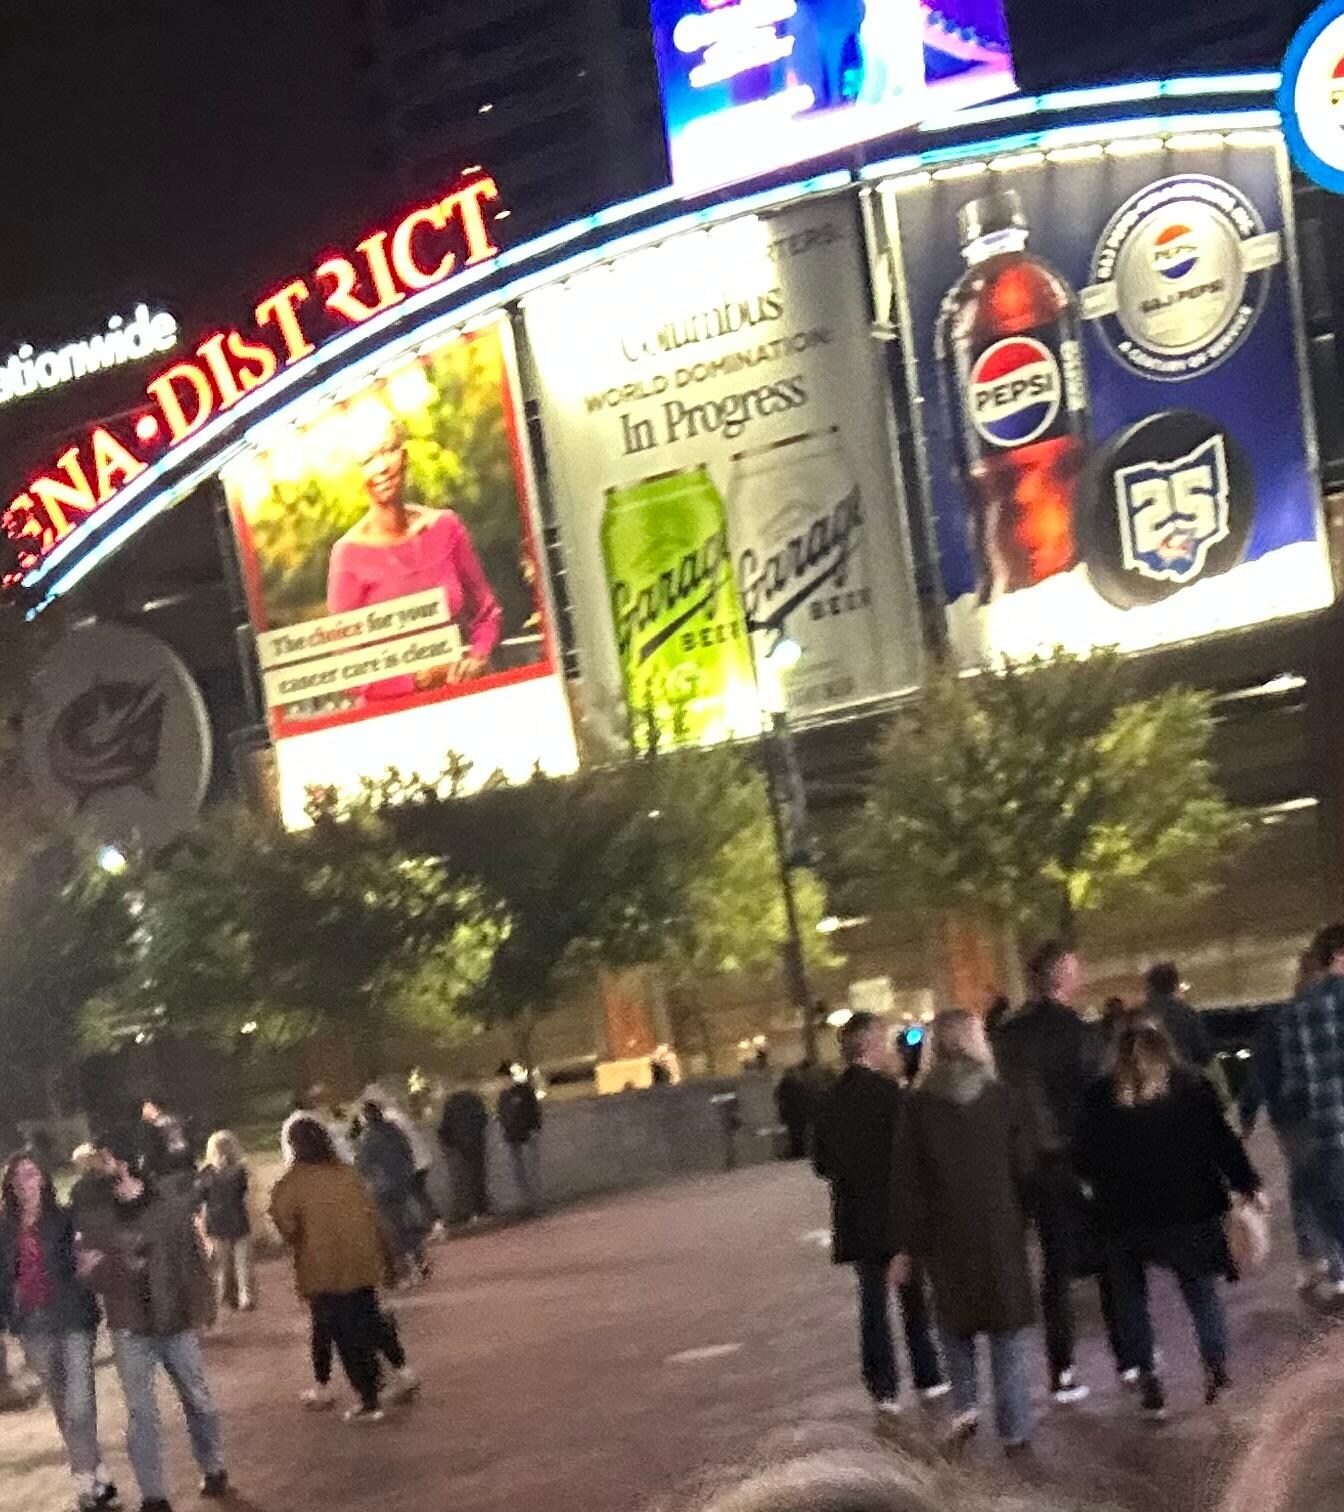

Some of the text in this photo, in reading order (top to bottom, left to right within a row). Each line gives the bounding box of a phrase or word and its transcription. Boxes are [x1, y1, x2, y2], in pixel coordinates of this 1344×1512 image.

[147, 177, 499, 447] DISTRICT
[621, 288, 784, 362] Clumbus
[584, 327, 833, 413] WORLD DOMINATION
[975, 373, 1054, 411] PEPSI
[619, 375, 809, 455] In Progress
[1130, 464, 1217, 553] 25
[270, 601, 440, 657] The choice for your
[278, 667, 339, 694] cancer
[341, 658, 380, 681] care
[382, 648, 400, 675] is
